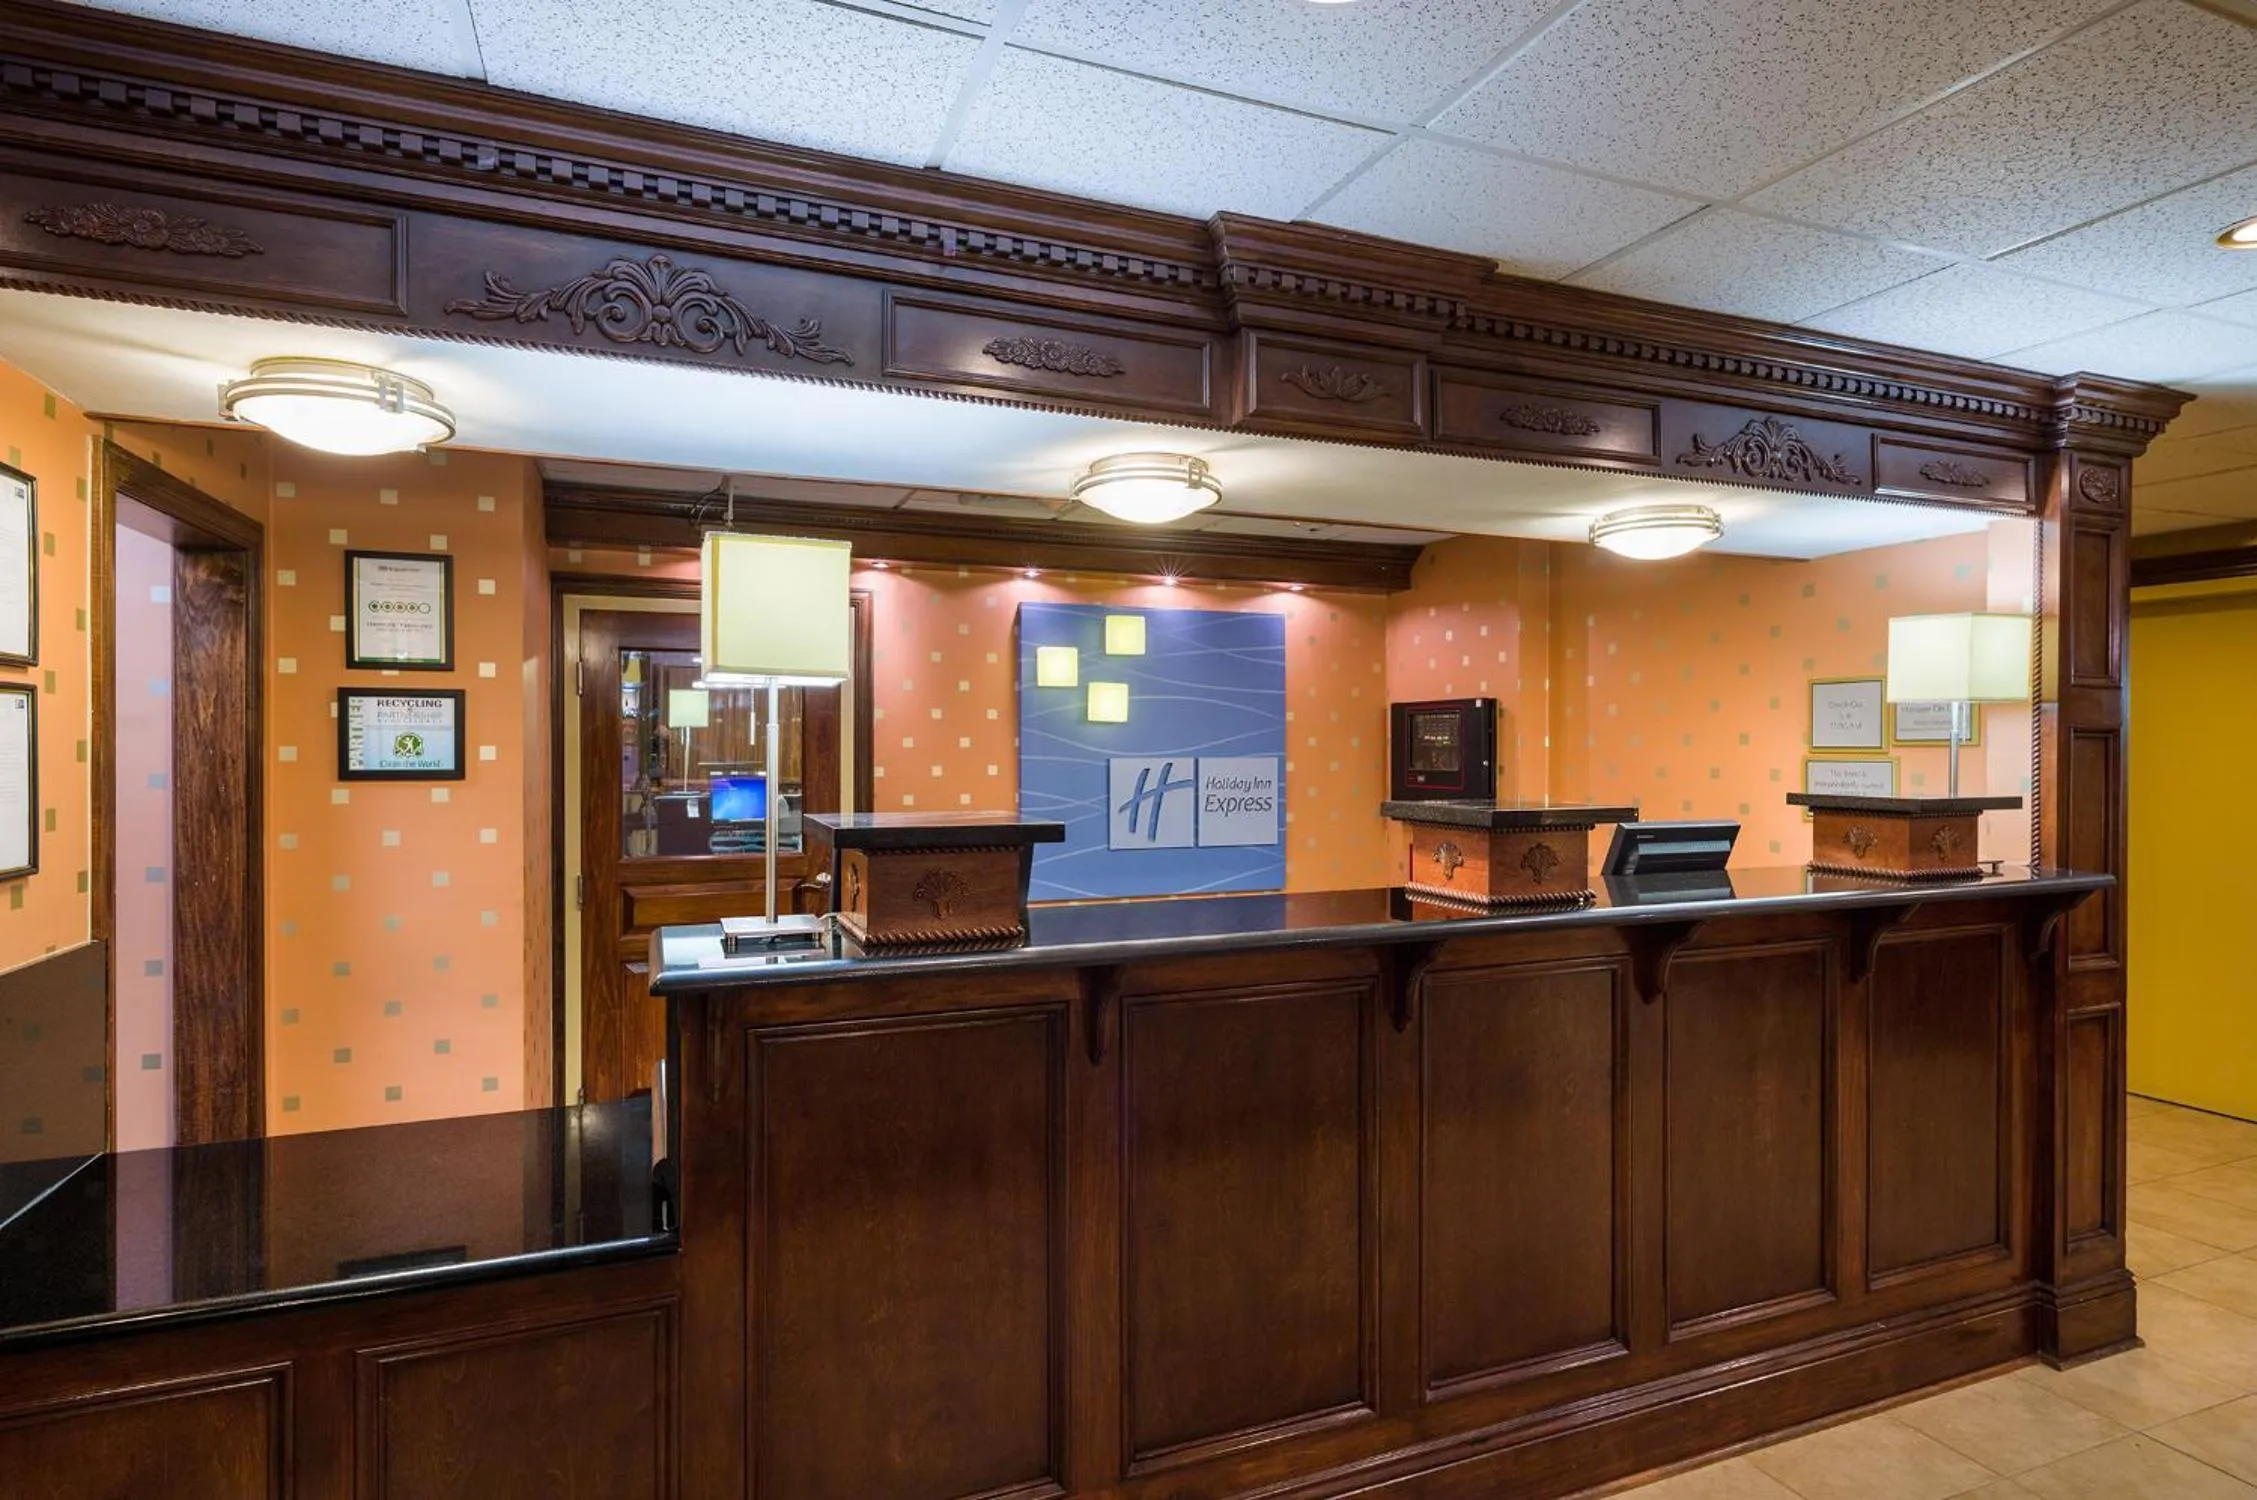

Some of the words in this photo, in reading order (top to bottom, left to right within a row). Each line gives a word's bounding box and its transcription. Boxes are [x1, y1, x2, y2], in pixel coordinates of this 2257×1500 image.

[377, 699, 443, 708] RECYCLING
[1206, 776, 1251, 793] Holiday
[1253, 777, 1272, 790] Inn
[1204, 794, 1273, 817] Express
